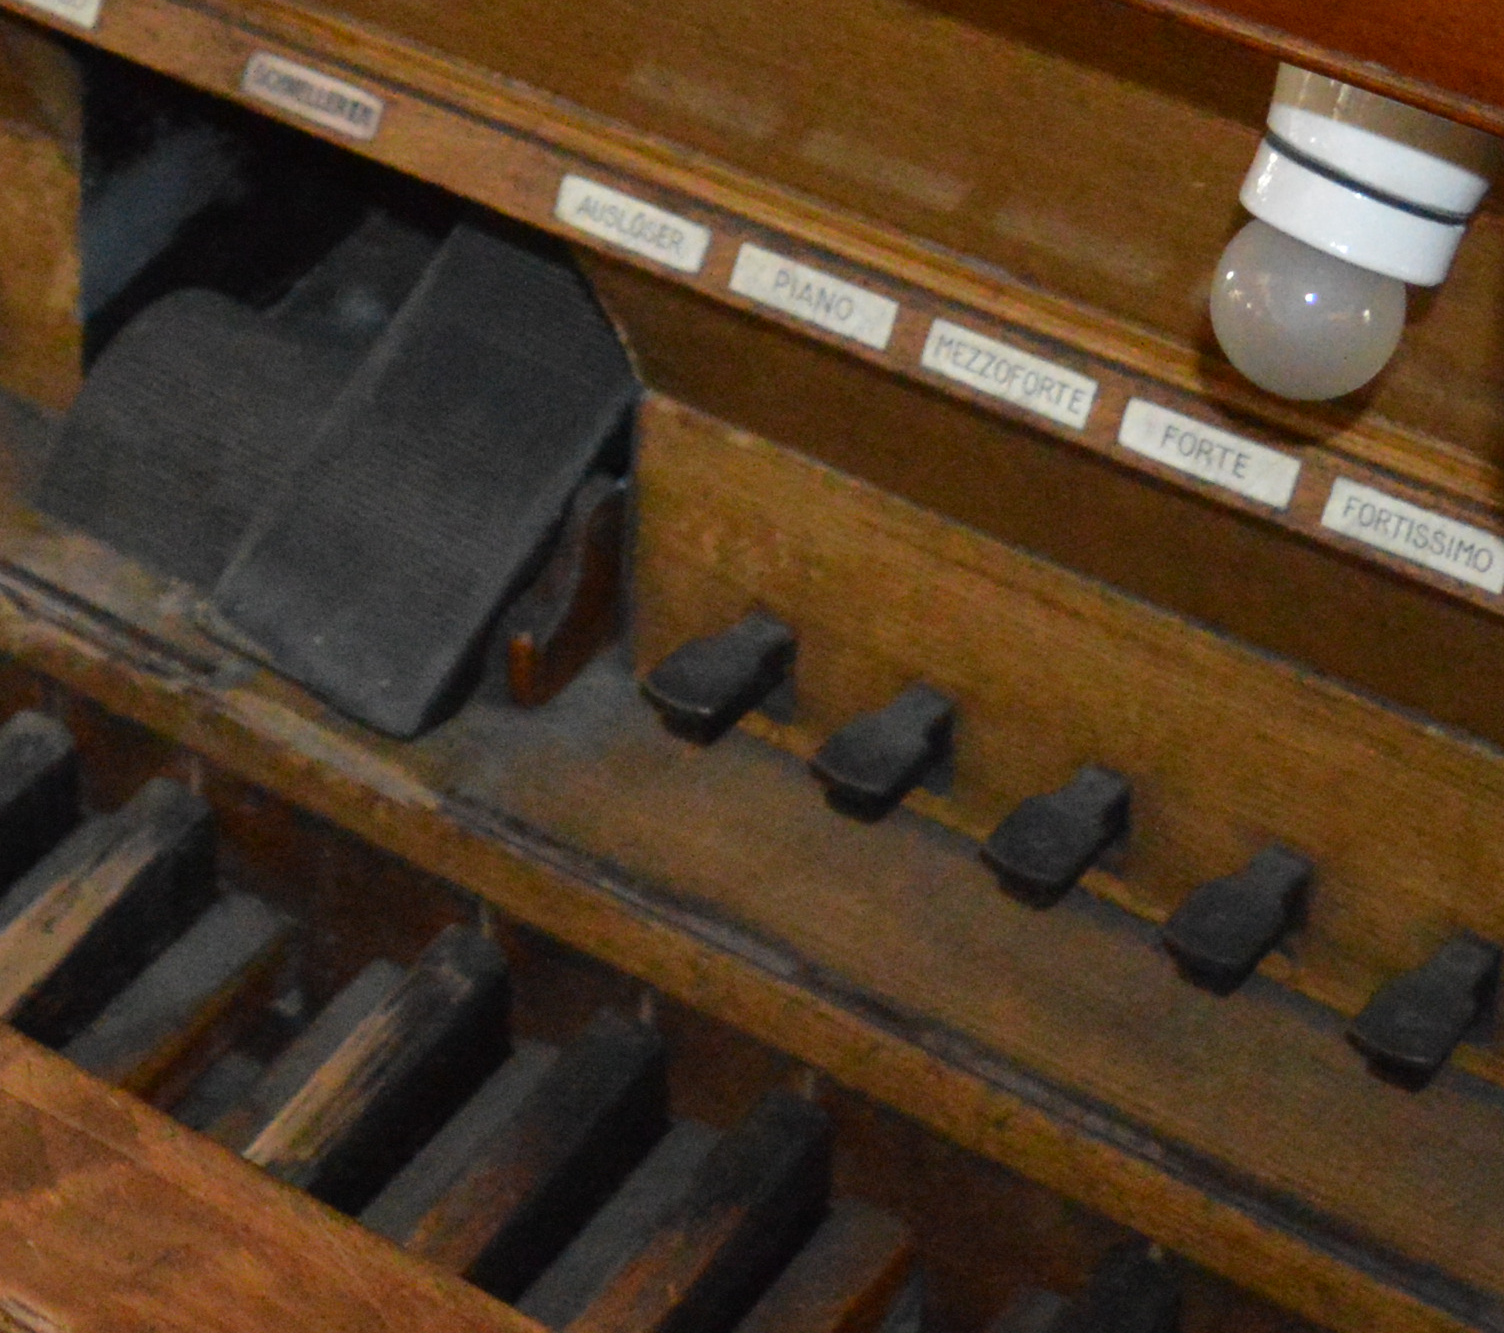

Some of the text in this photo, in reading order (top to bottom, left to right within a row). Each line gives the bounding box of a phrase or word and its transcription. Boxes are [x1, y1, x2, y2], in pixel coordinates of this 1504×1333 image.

[576, 194, 686, 255] AUSLÖSER
[773, 269, 855, 322] PIANO
[933, 335, 1088, 414] MEZZOFORTE
[1160, 423, 1252, 480] FORTE
[1342, 494, 1495, 574] FORTISSIMO
